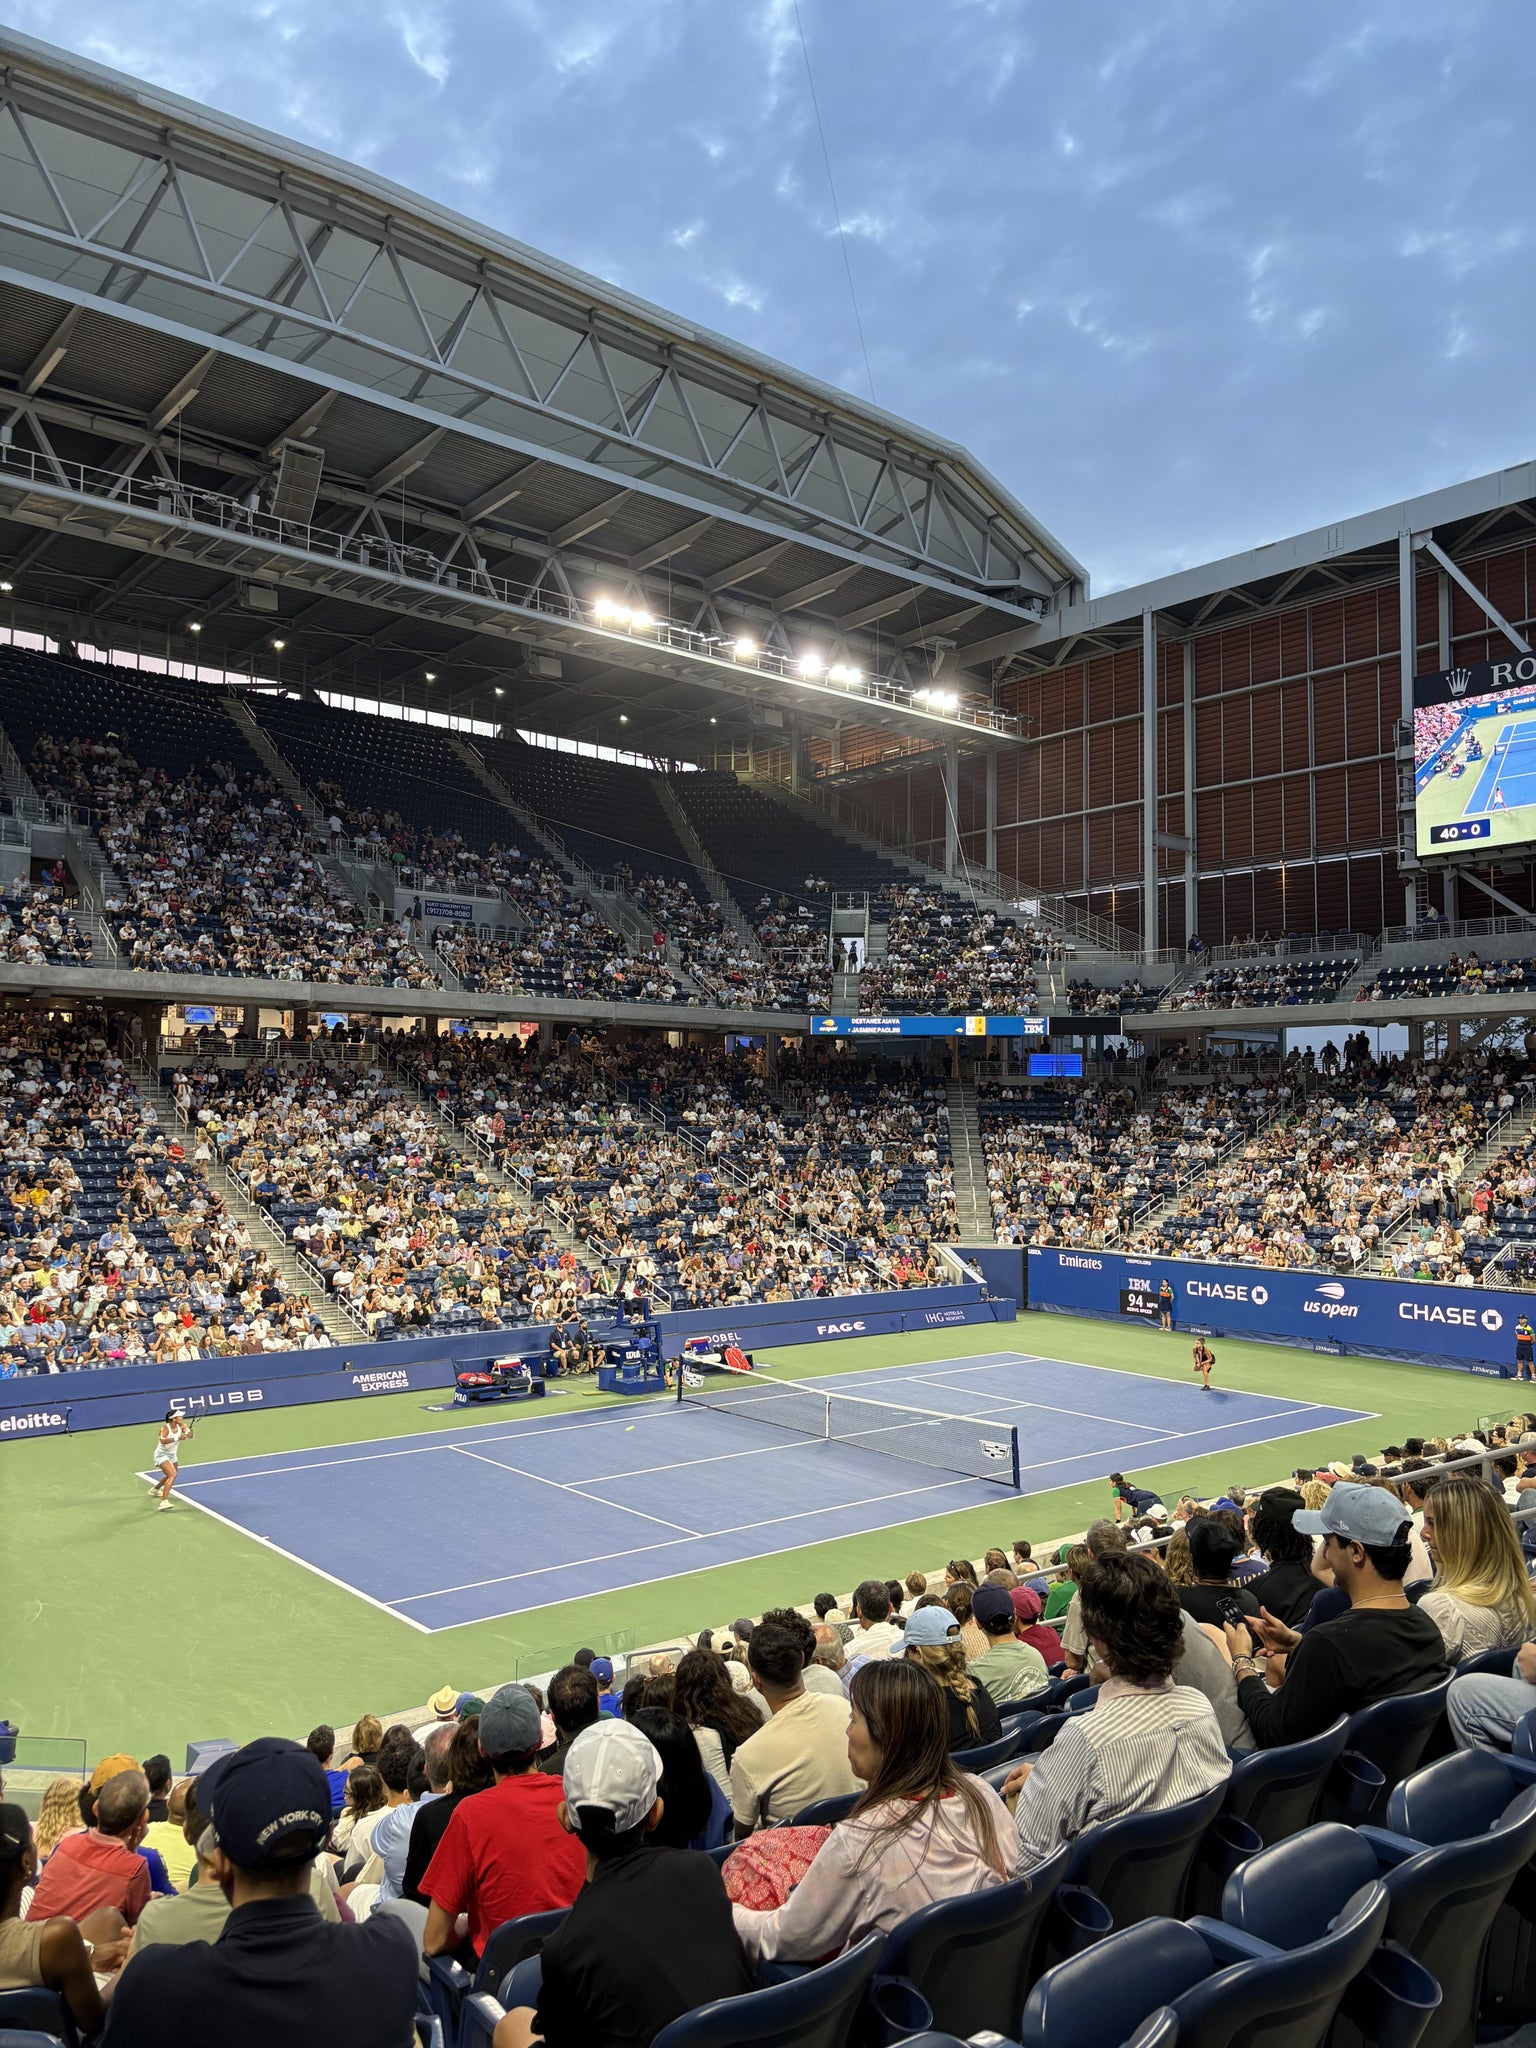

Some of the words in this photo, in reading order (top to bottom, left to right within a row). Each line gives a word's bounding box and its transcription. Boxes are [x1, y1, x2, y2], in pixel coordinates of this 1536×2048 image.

[1490, 657, 1536, 687] RO
[1440, 827, 1459, 840] 40
[1470, 824, 1480, 835] 0
[426, 907, 471, 918] (917)708-8080
[1024, 1025, 1044, 1033] IBM
[1059, 1253, 1103, 1270] Emirates
[1128, 1277, 1152, 1292] IBM
[1186, 1280, 1249, 1302] CHASE
[1128, 1293, 1144, 1308] 94
[1303, 1301, 1320, 1313] us
[1322, 1303, 1358, 1319] open
[1399, 1302, 1478, 1327] CHASE
[925, 1312, 945, 1324] IHG
[816, 1321, 866, 1336] FAGE
[352, 1370, 407, 1384] AMERICAN
[361, 1379, 410, 1392] EXPRESS
[170, 1389, 263, 1411] CHUBB
[454, 1392, 467, 1403] POLO
[256, 1820, 278, 1846] NEW
[279, 1809, 309, 1826] YORK
[309, 1810, 323, 1826] CITY
